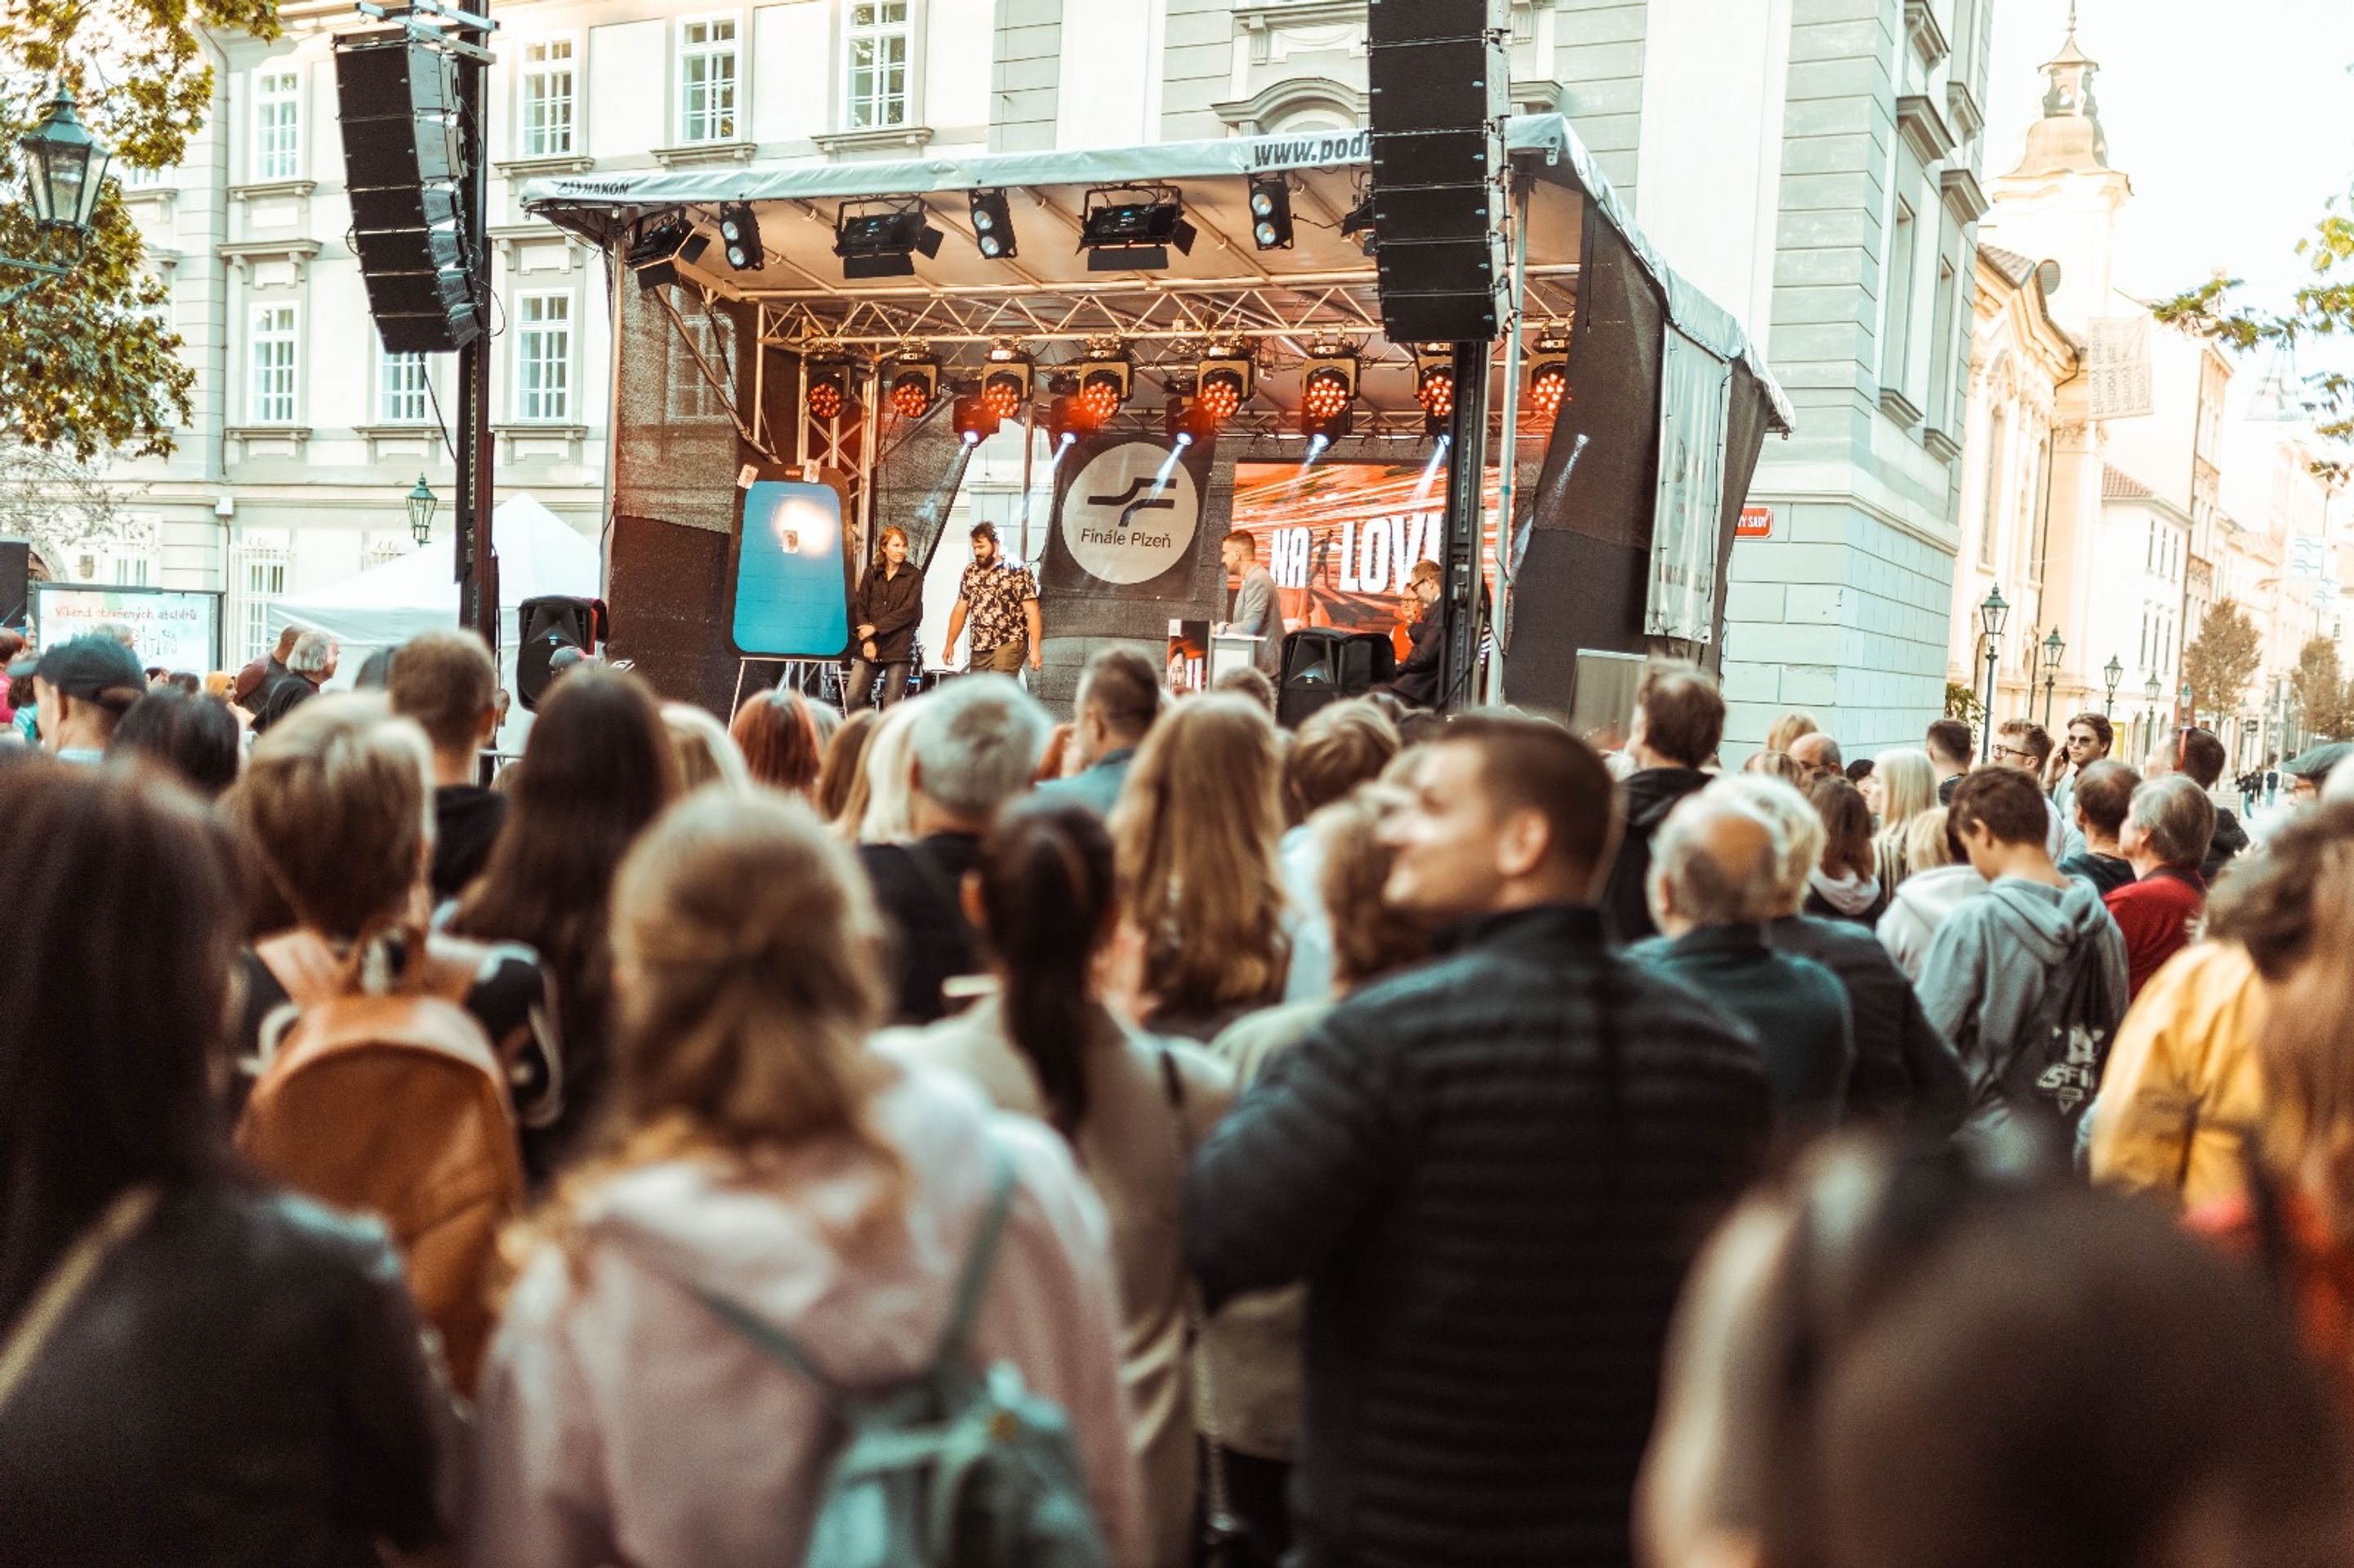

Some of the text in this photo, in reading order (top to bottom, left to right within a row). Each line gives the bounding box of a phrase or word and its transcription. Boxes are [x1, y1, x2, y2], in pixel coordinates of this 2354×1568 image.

[1747, 514, 1764, 528] SADY
[1081, 528, 1171, 548] Finále Plzeň
[1269, 526, 1310, 588] NA
